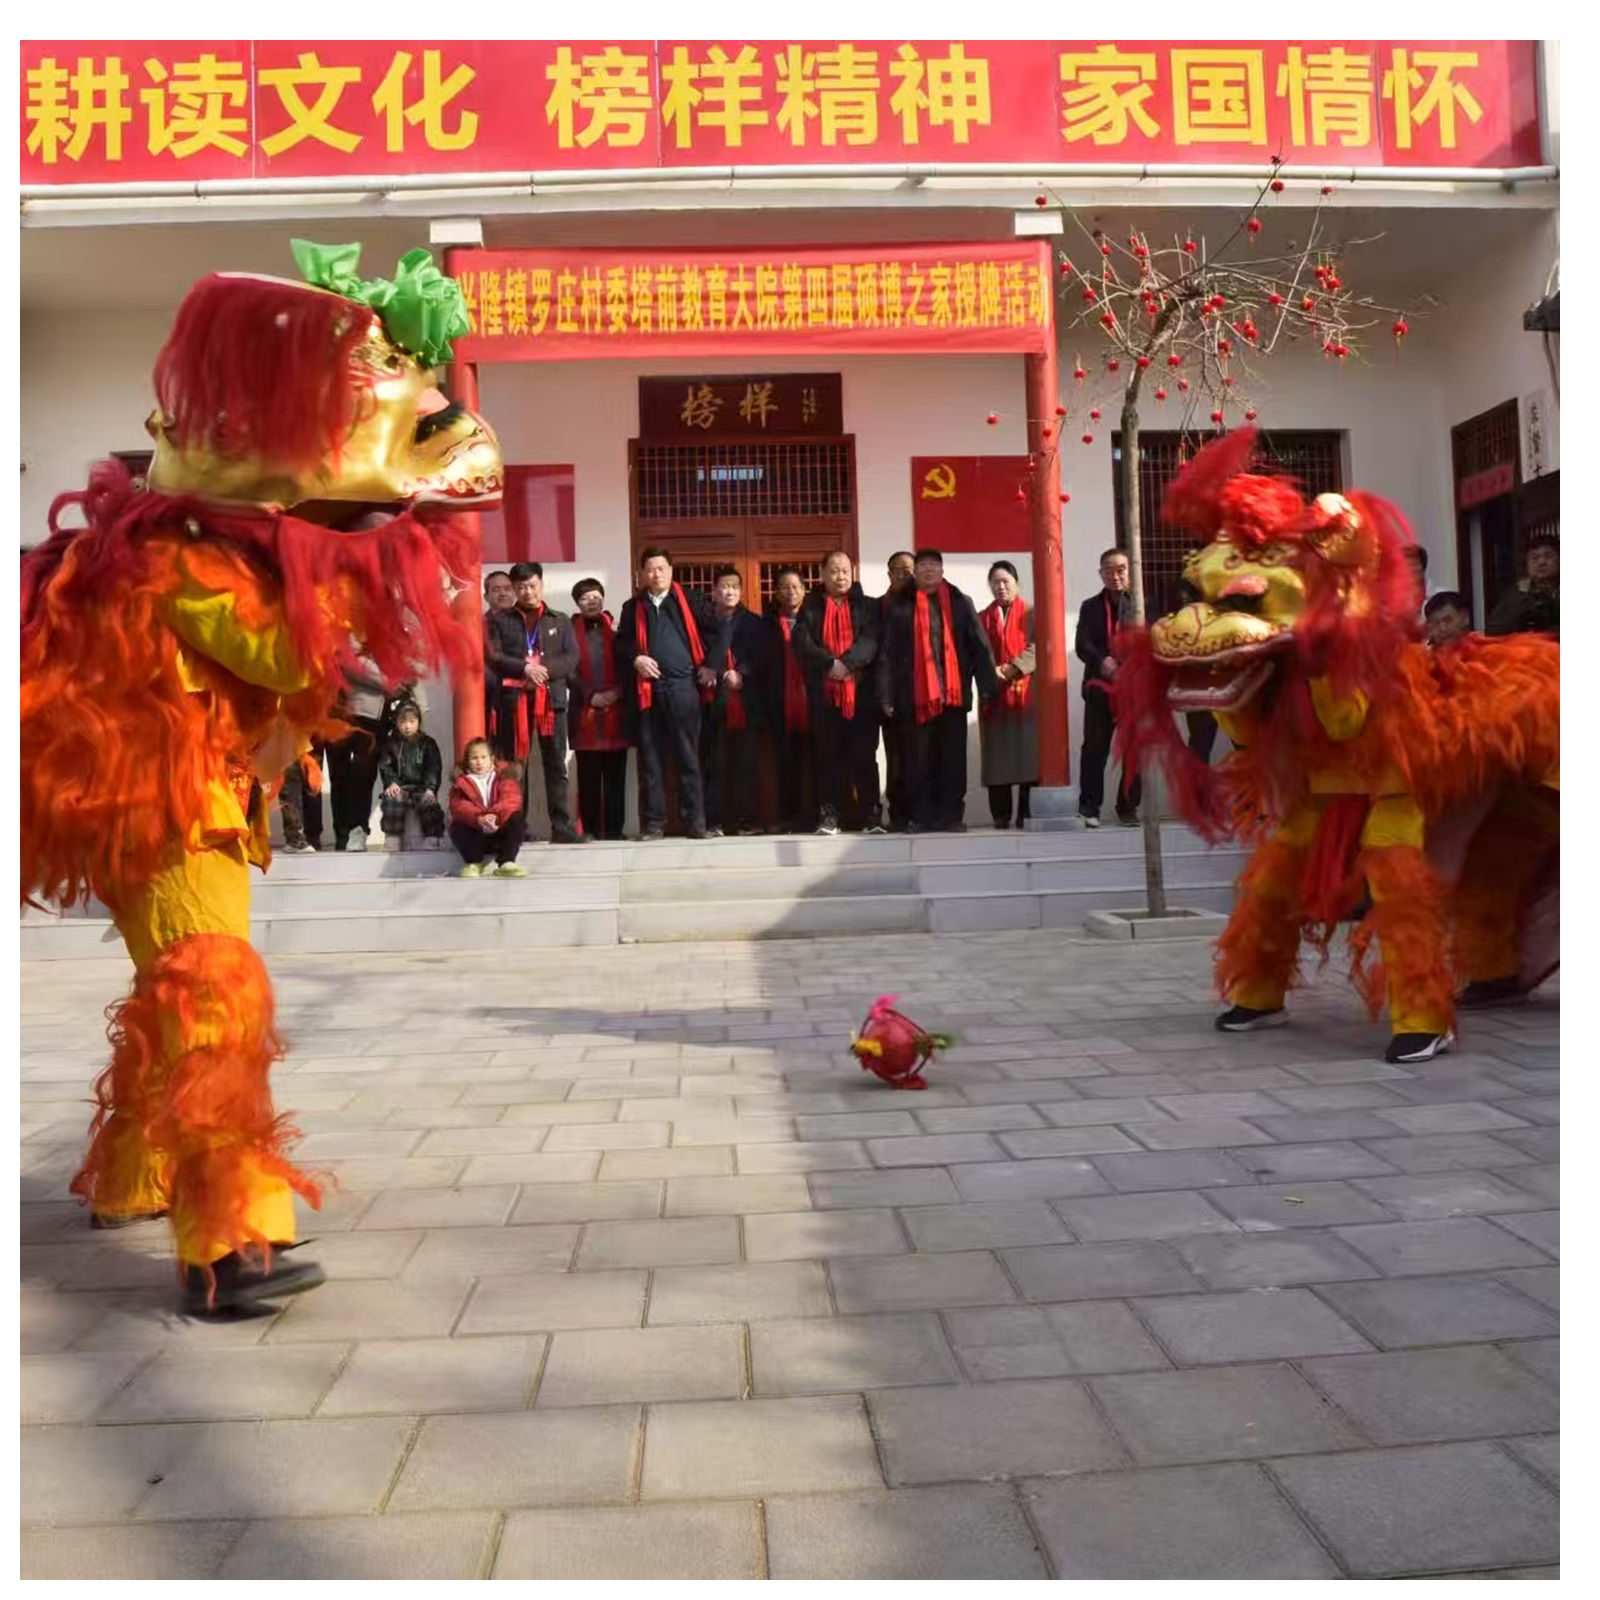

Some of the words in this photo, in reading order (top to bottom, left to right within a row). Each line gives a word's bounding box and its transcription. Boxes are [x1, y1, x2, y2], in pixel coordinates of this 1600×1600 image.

[27, 44, 480, 163] 耕读文化
[545, 44, 992, 149] 榜样精神
[1059, 44, 1483, 149] 家国情怀
[681, 382, 778, 429] 榜样
